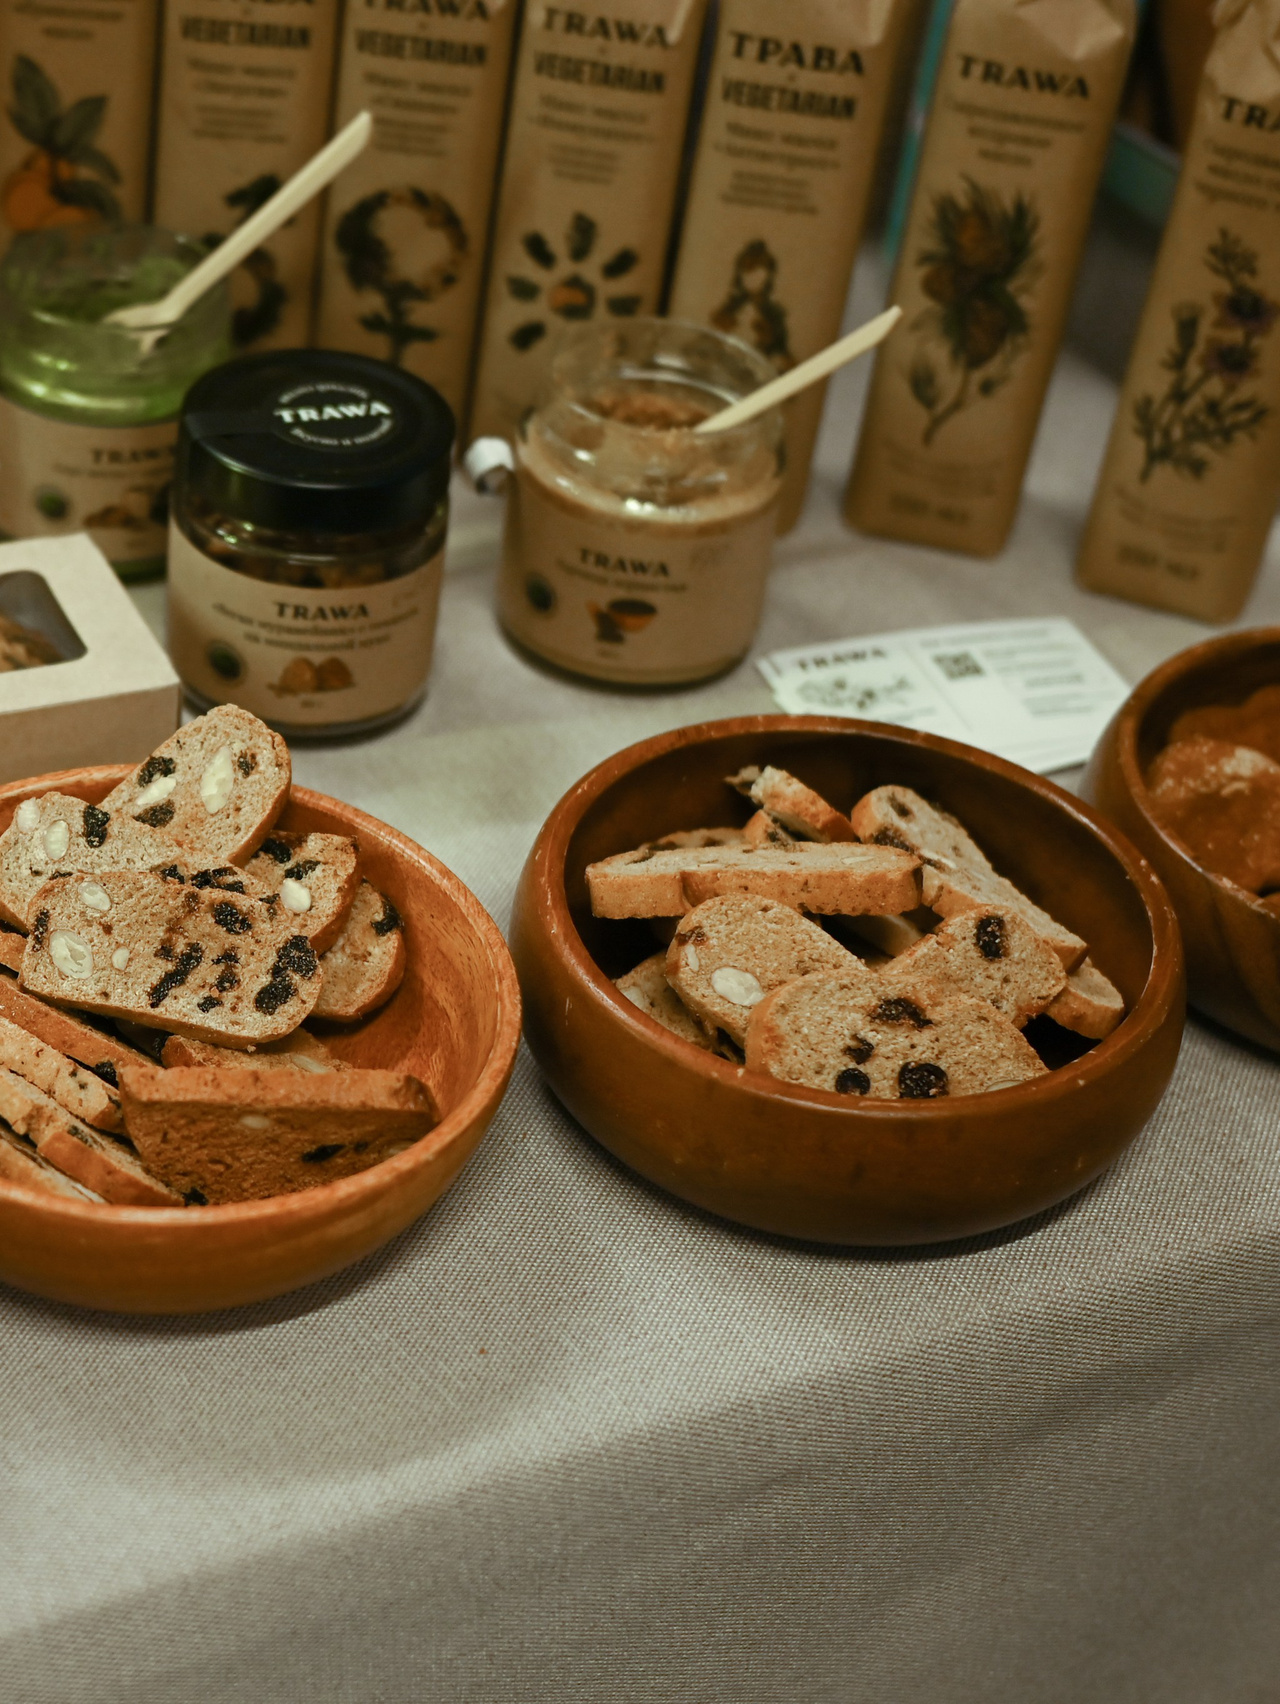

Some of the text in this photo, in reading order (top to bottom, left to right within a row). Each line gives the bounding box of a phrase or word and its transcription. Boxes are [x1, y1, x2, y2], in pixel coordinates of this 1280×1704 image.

[544, 8, 668, 48] TRAWA
[957, 54, 1089, 99] TRAWA
[274, 401, 391, 423] TRAWA
[578, 548, 670, 577] TRAWA
[275, 602, 370, 620] TRAWA
